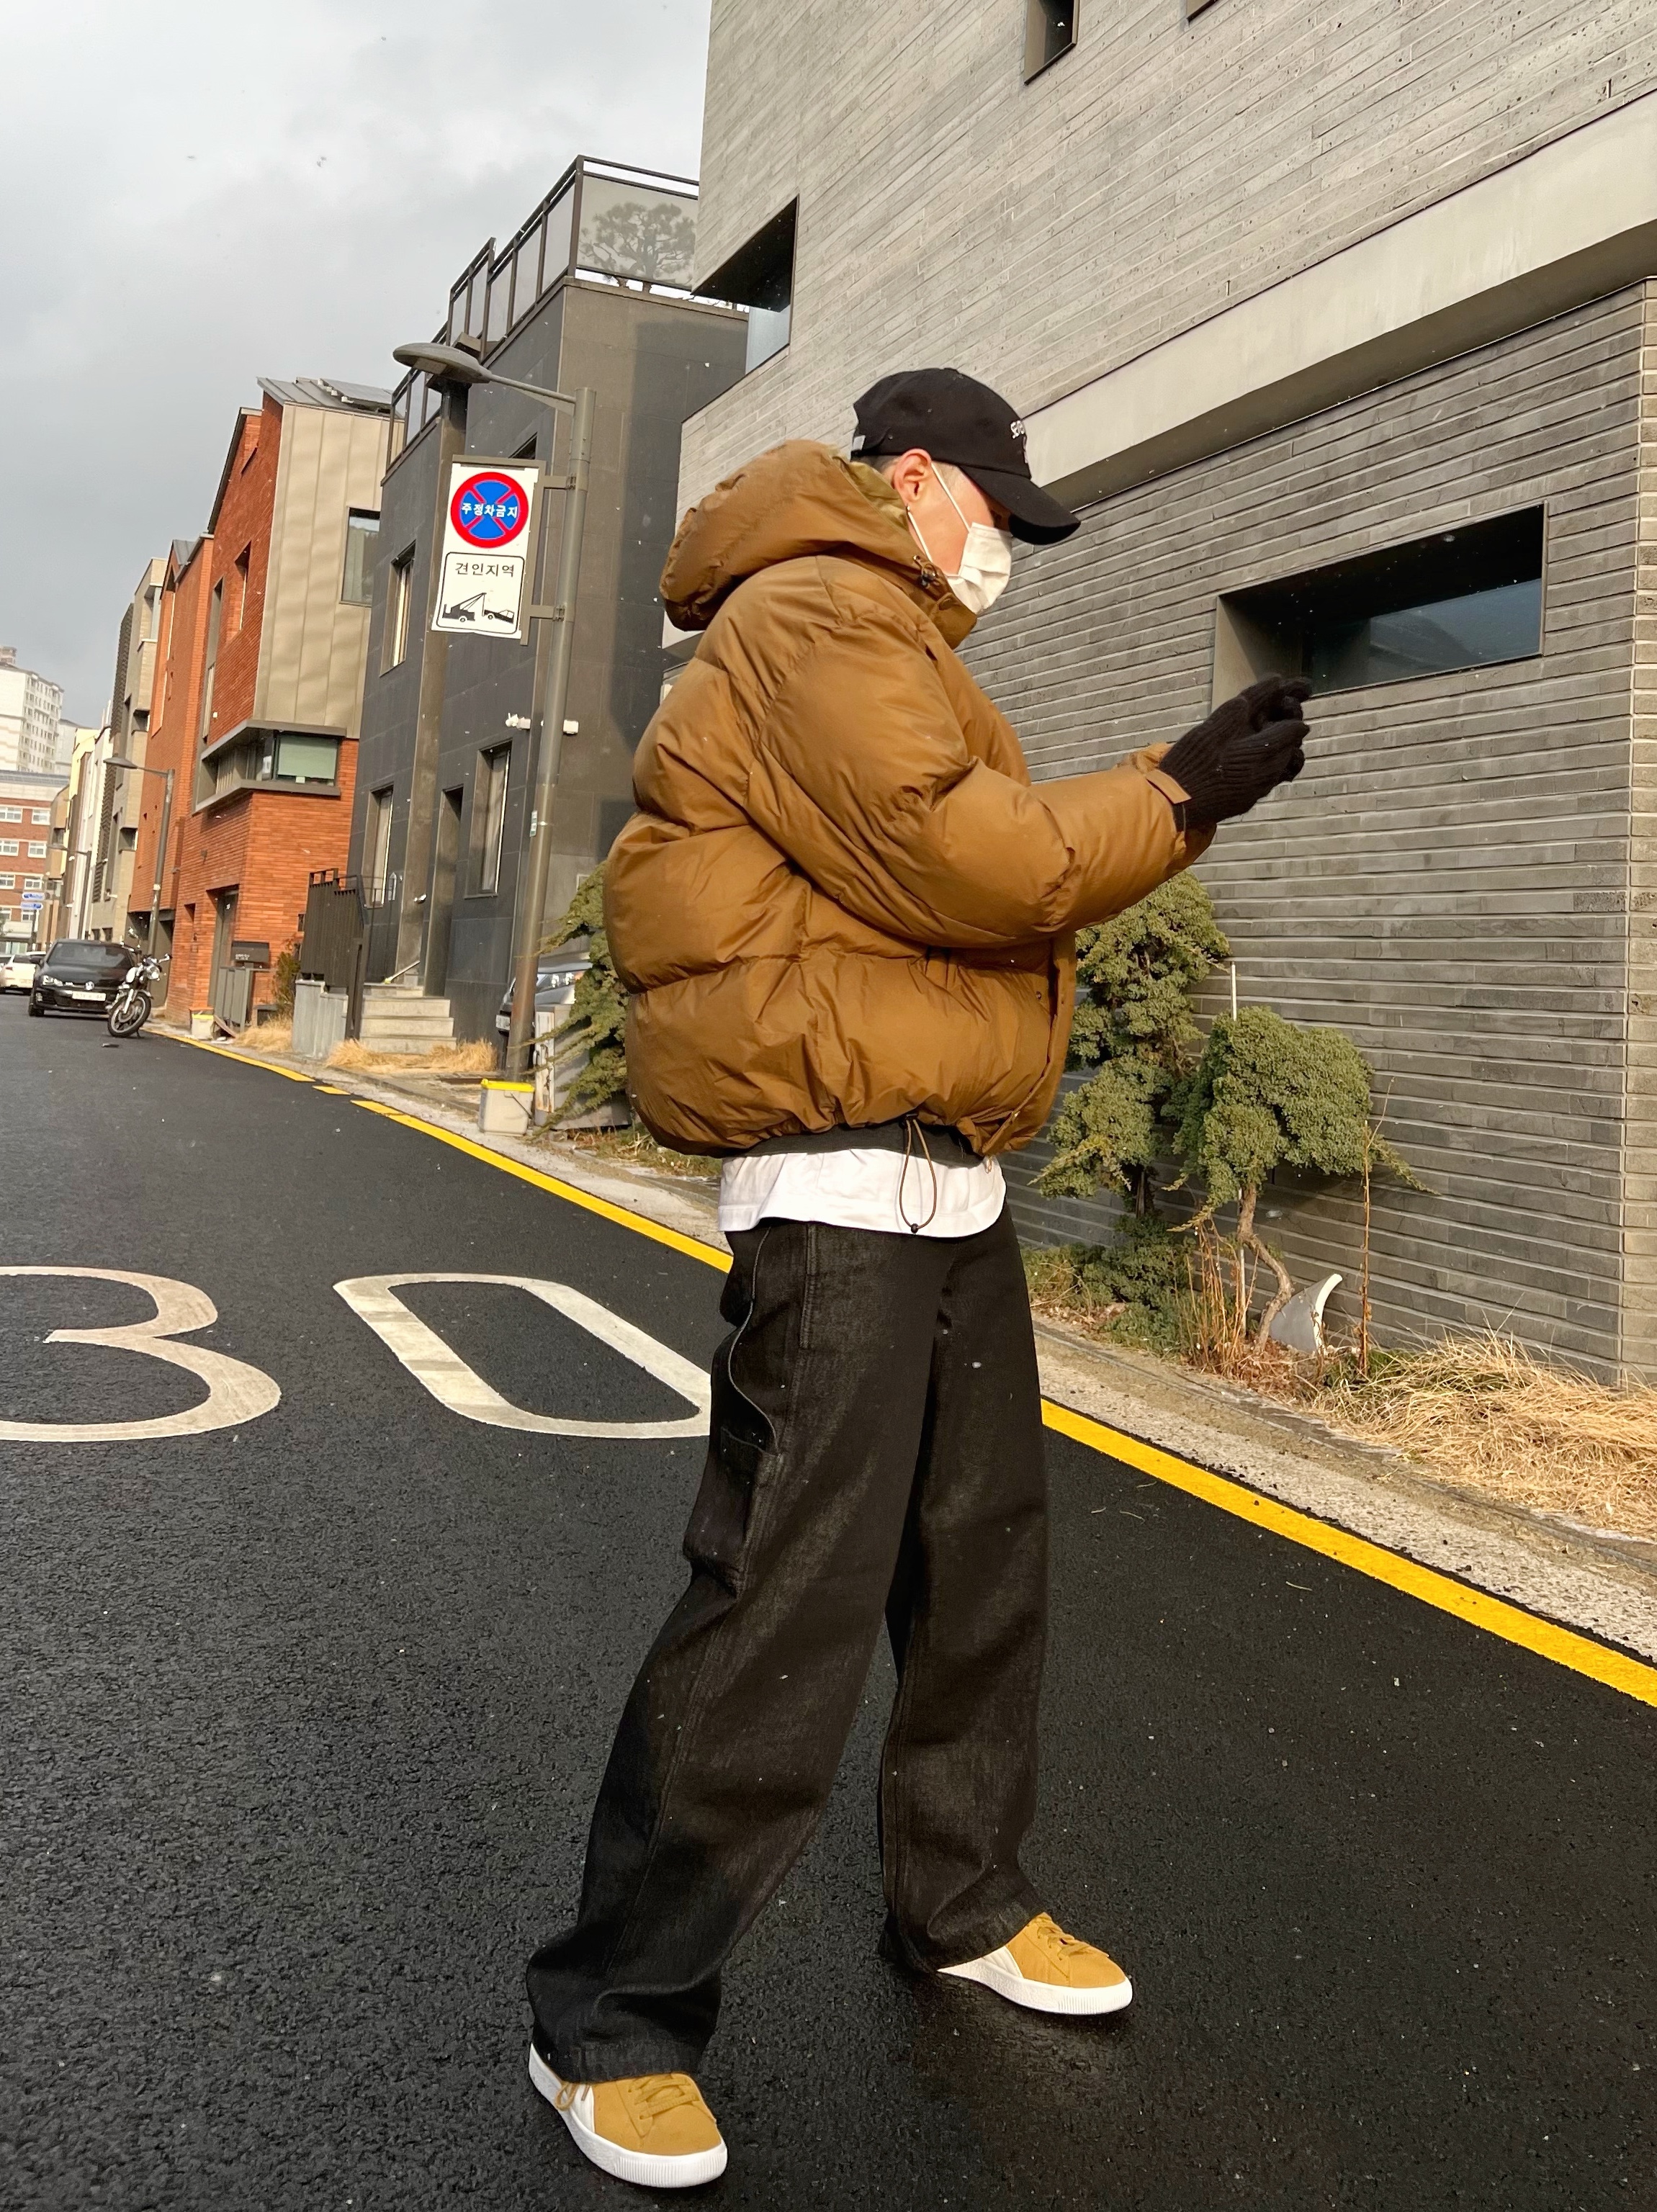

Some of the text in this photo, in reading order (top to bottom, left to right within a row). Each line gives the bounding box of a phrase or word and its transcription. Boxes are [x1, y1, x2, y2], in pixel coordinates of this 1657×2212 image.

[461, 503, 518, 518] 주정차금지
[455, 562, 514, 577] 견인지역
[0, 1266, 711, 1442] 30
